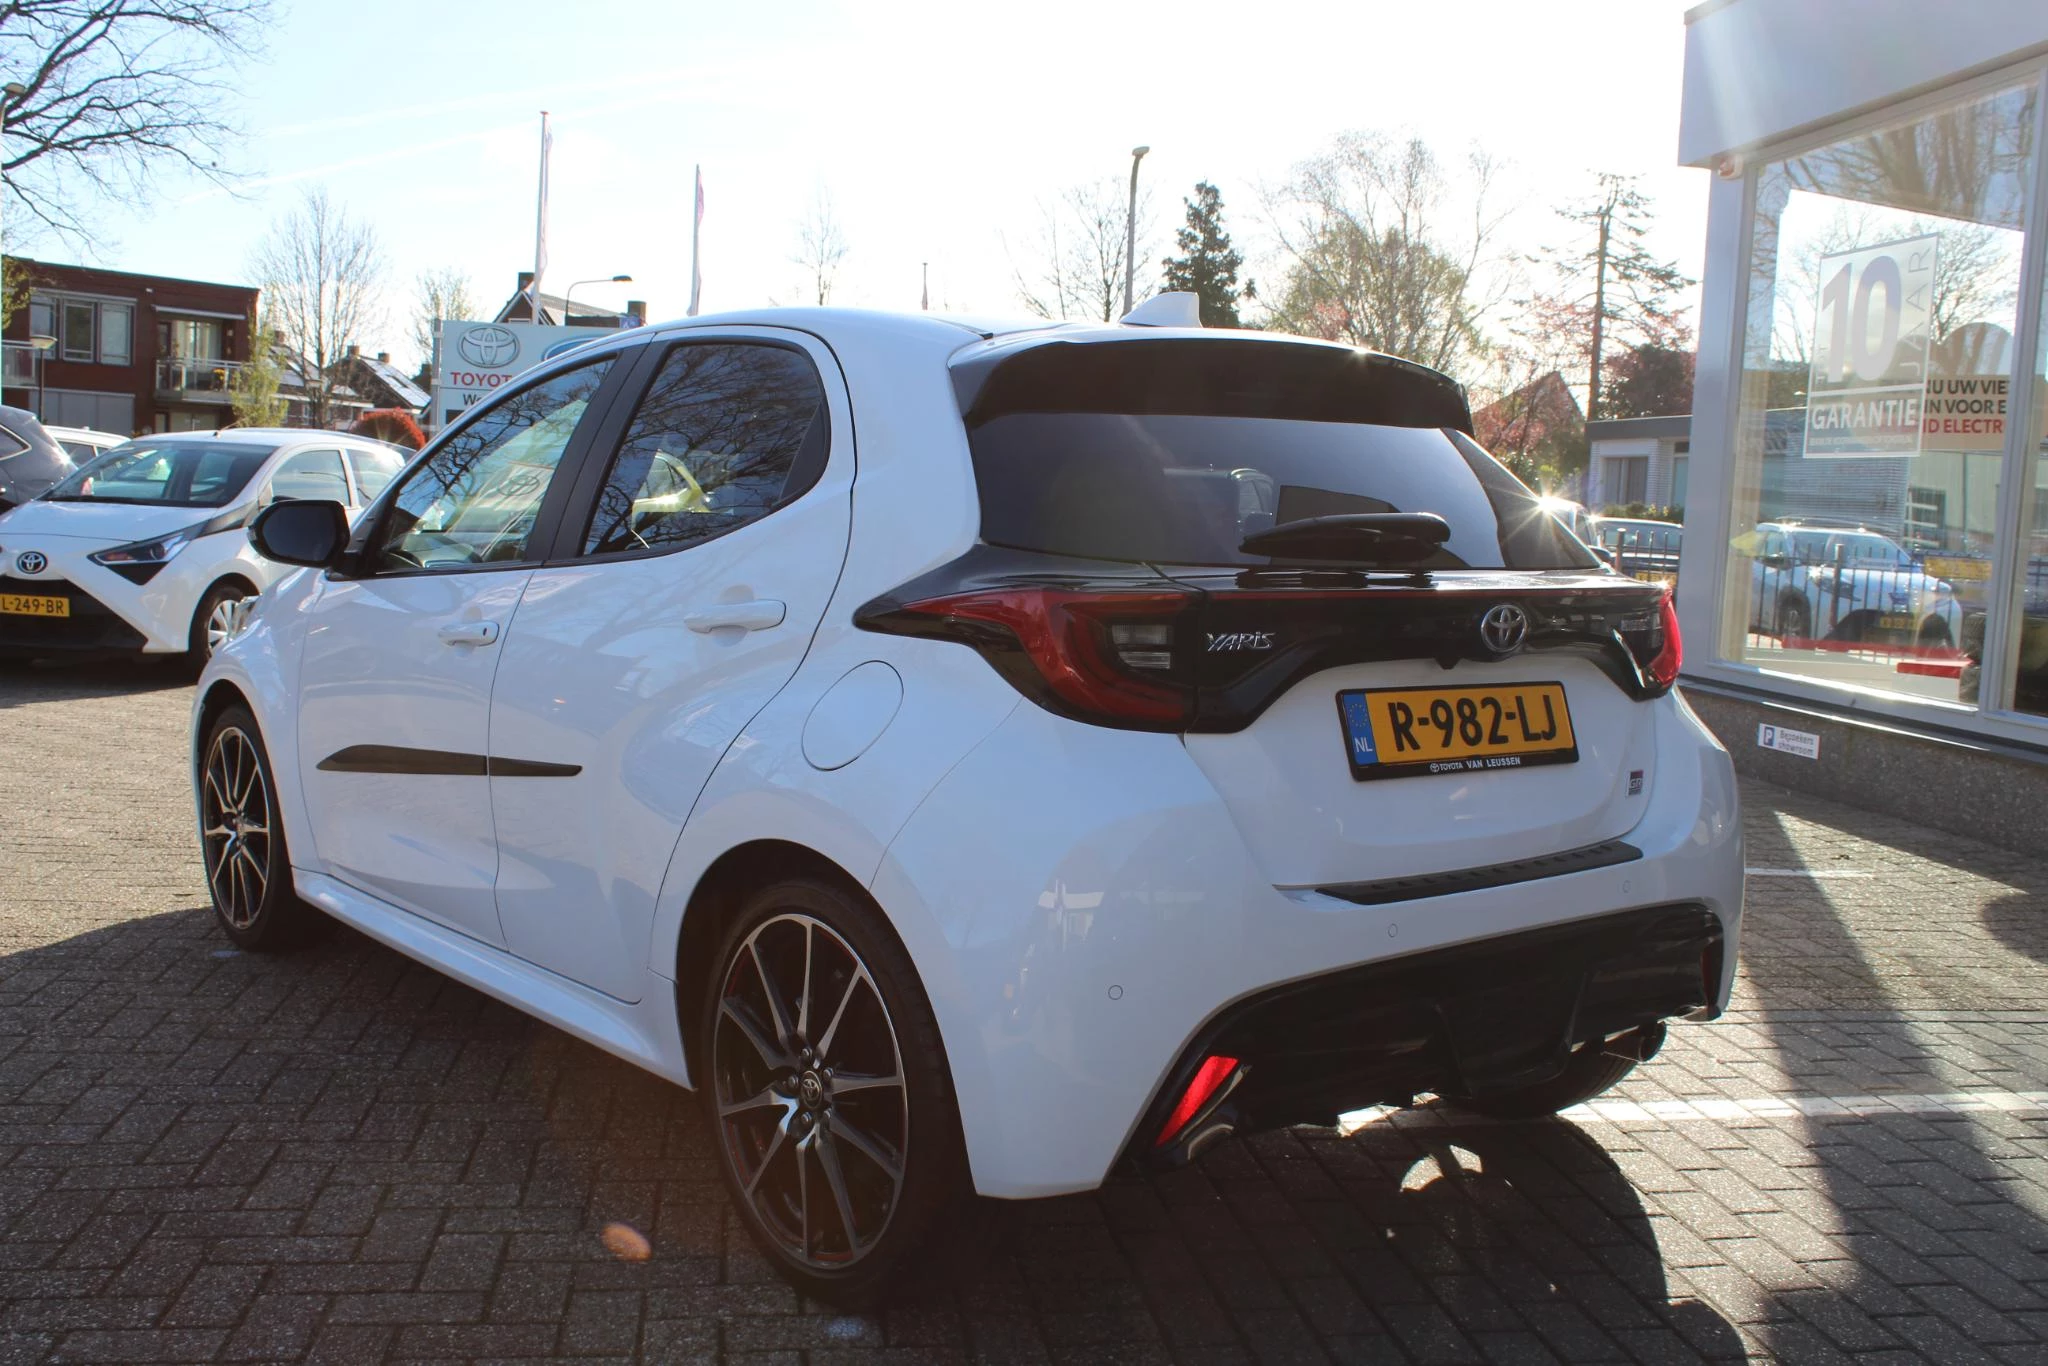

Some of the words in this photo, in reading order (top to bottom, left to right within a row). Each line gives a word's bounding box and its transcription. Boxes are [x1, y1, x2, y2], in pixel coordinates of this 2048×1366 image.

[1821, 255, 1902, 383] 10
[1899, 248, 1931, 376] JAAR
[1947, 380, 1978, 395] UW
[1981, 380, 2009, 395] VIE
[1811, 398, 1918, 430] GARANTIE
[1945, 399, 1994, 414] VOOR
[2, 597, 64, 614] L-249-BR
[1388, 695, 1557, 752] R-982-LJ
[1354, 737, 1373, 753] NL
[1440, 761, 1464, 771] TOYOTA
[1466, 760, 1483, 769] VAN
[1487, 756, 1521, 767] LEUSSEN
